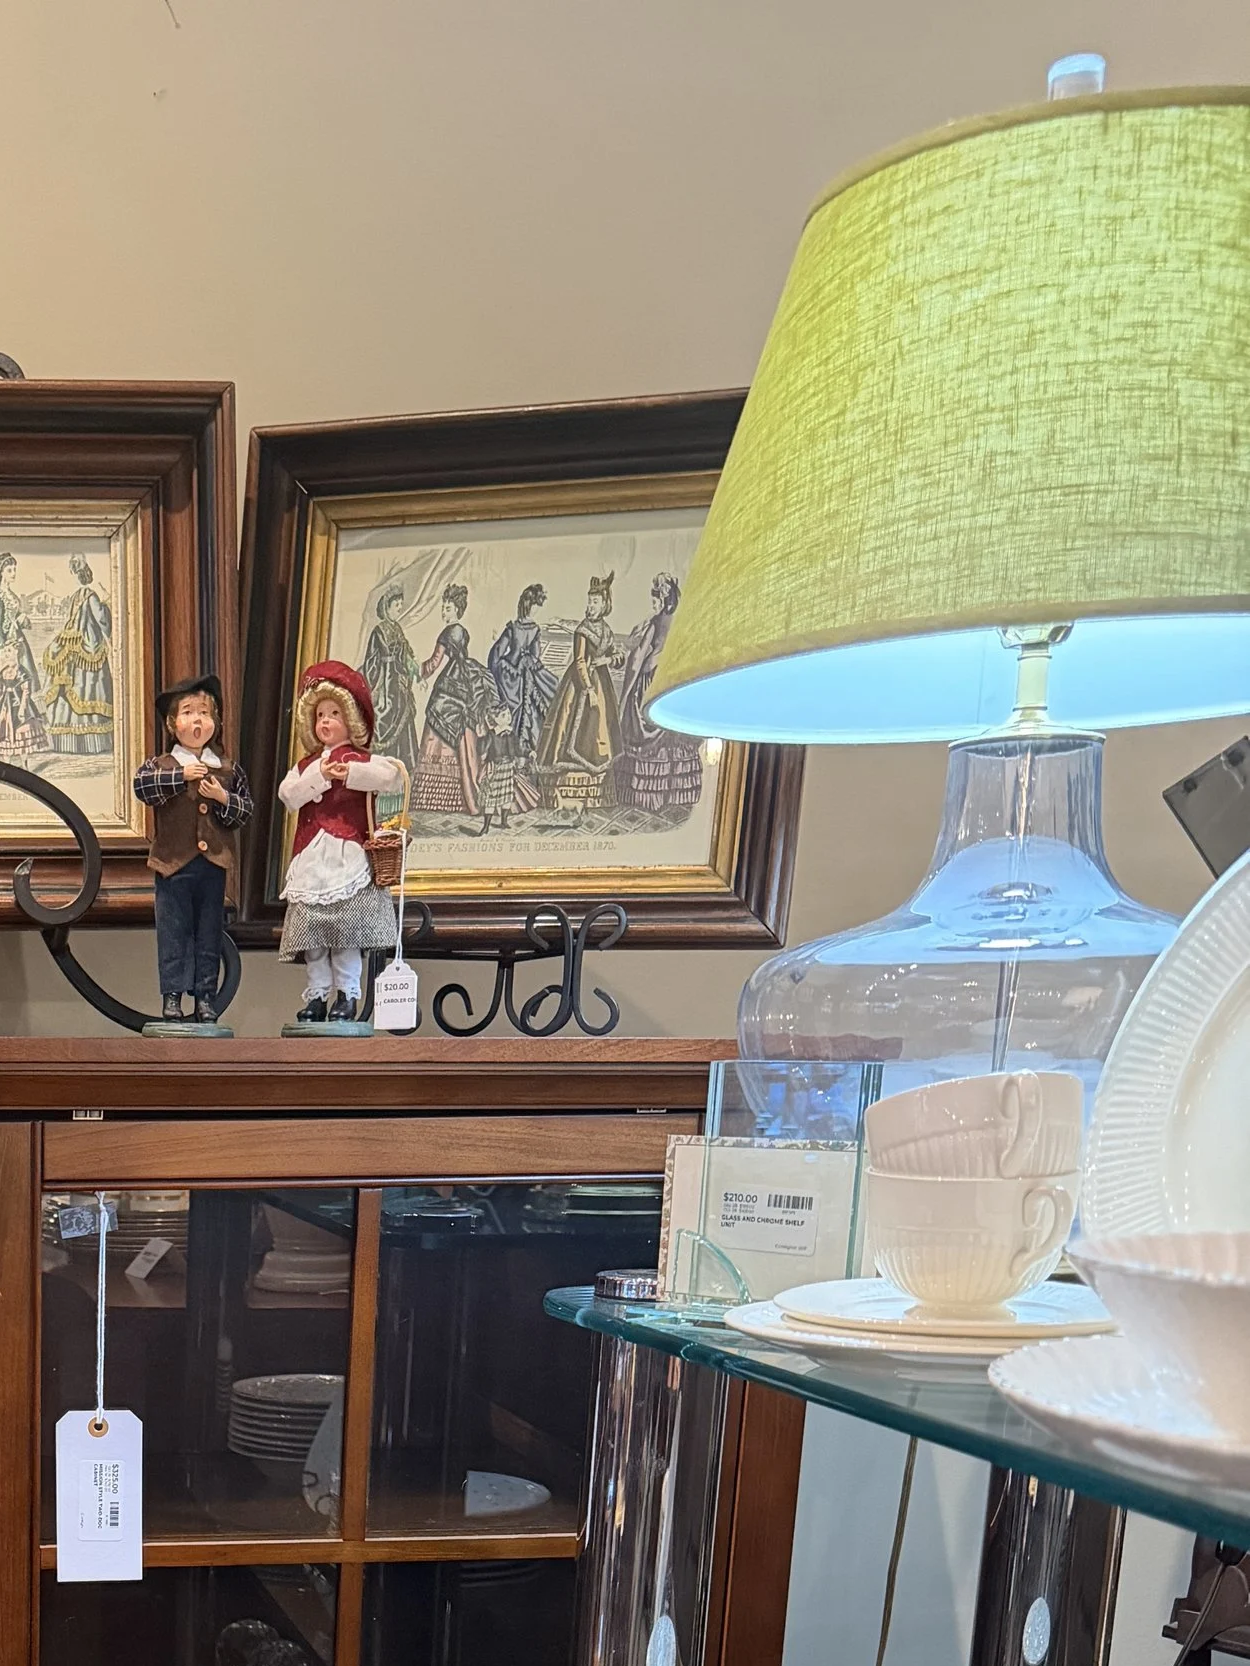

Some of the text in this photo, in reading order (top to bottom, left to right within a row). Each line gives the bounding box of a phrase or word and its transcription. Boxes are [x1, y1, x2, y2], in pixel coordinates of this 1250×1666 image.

[447, 842, 504, 853] FASHIONS
[509, 841, 530, 852] FOR
[534, 840, 590, 852] DECEMBER
[384, 982, 410, 992] $20.00
[723, 1192, 758, 1204] $210.00
[721, 1214, 741, 1222] GLASS
[756, 1217, 784, 1225] CHROME
[785, 1219, 805, 1227] SHELF
[111, 1463, 119, 1495] $325.00
